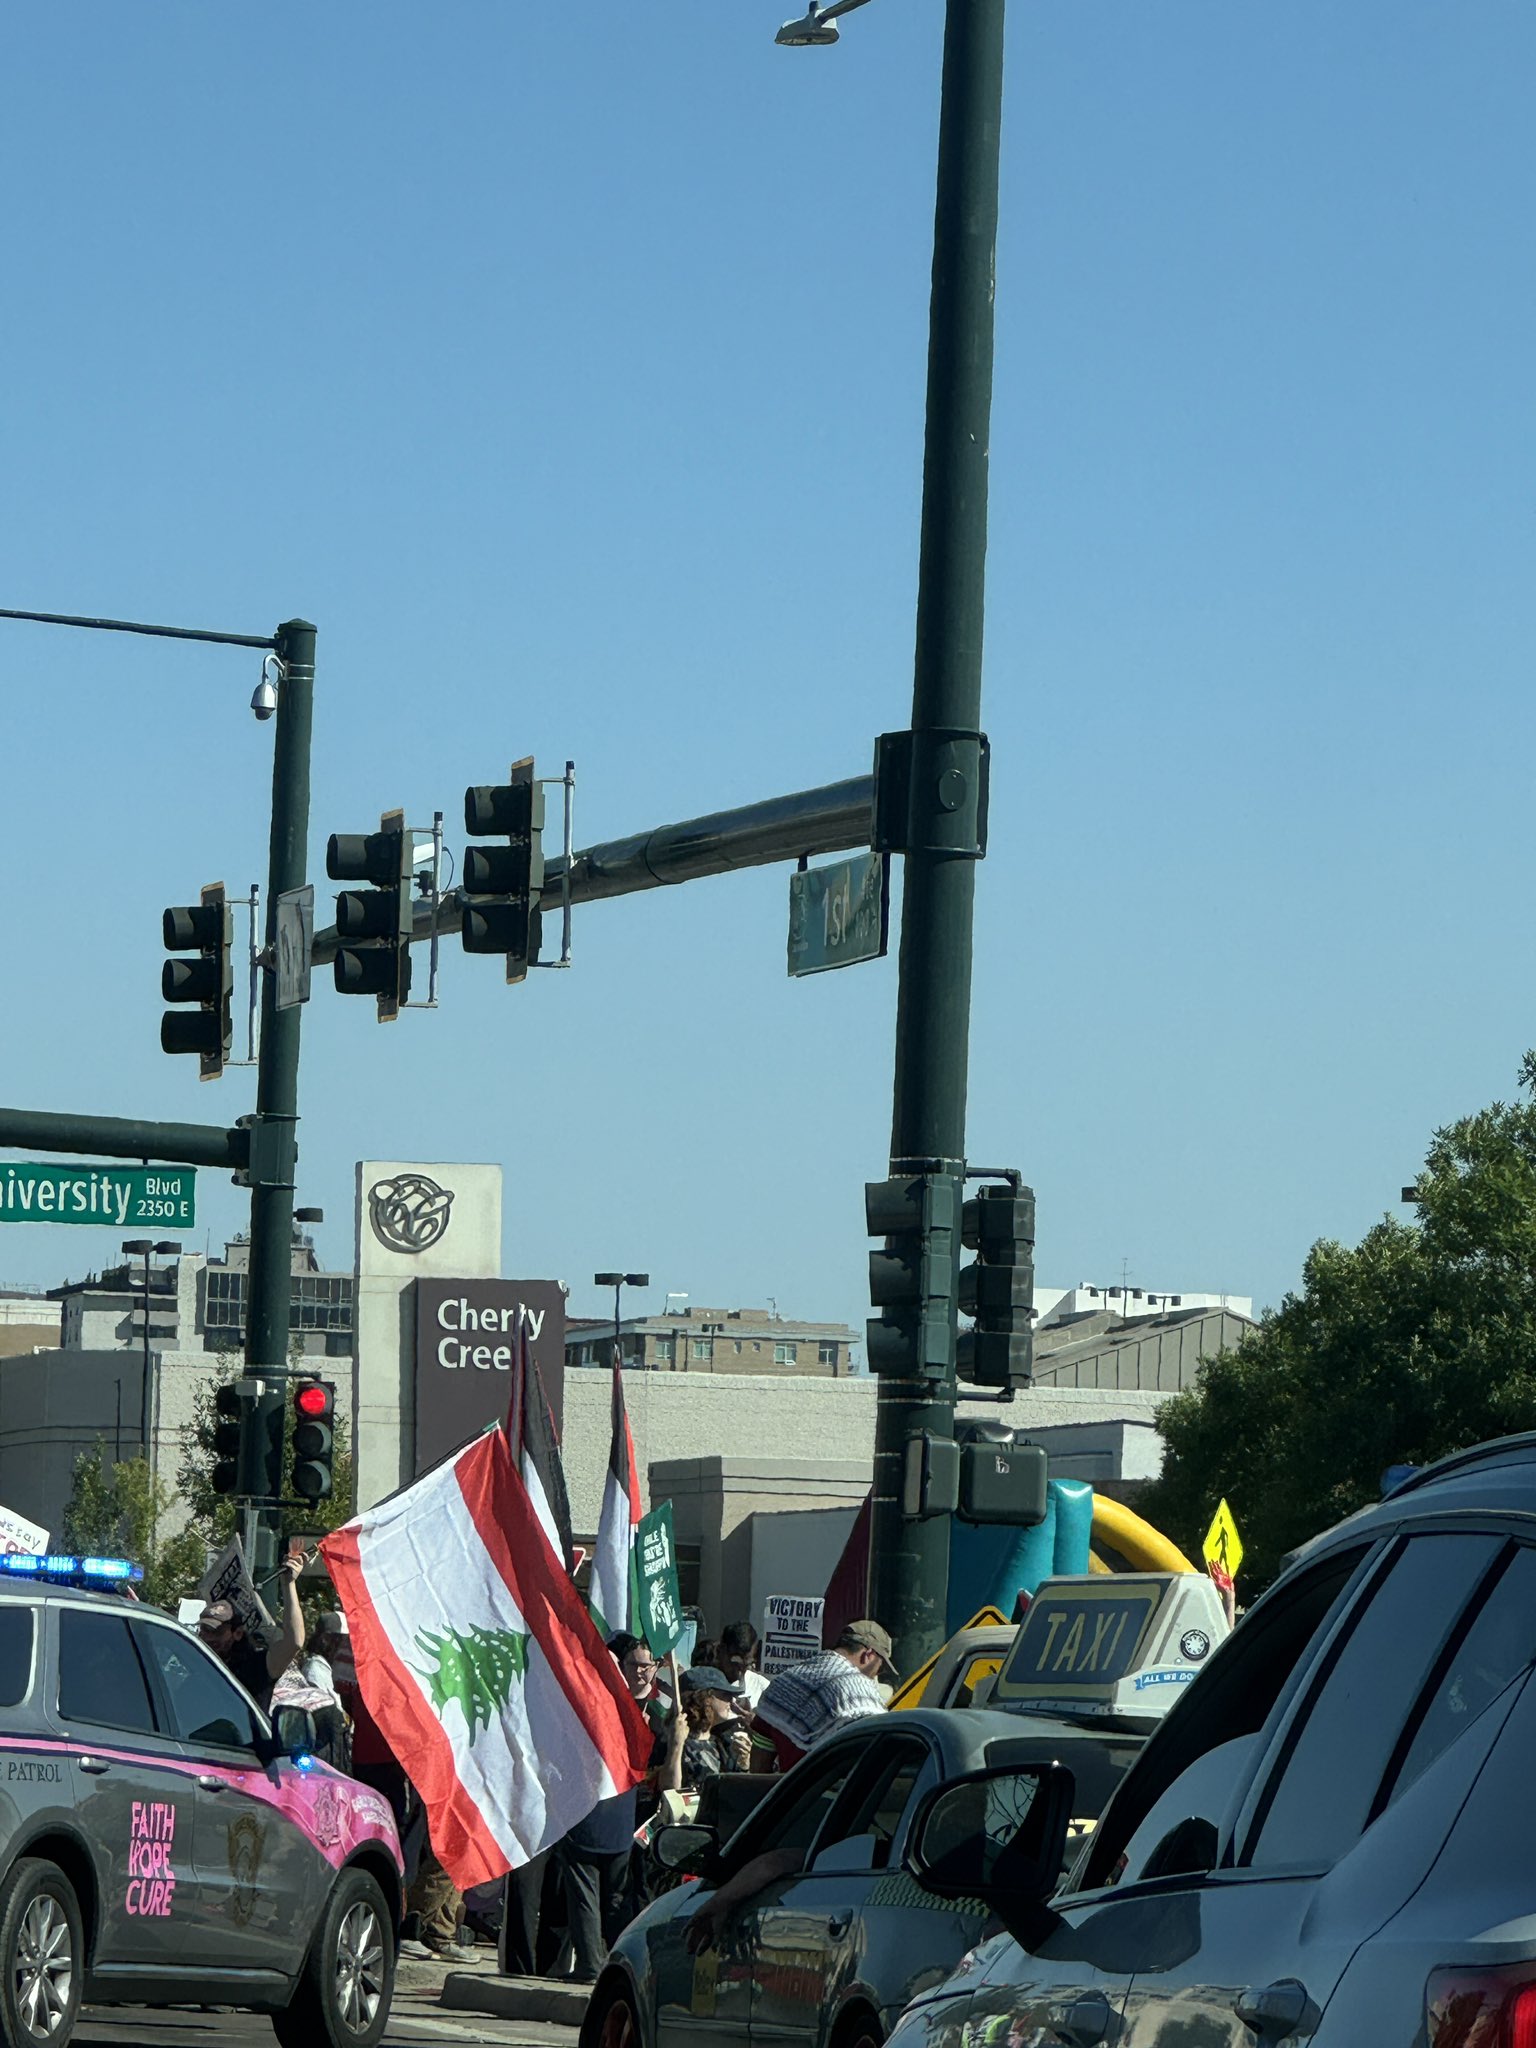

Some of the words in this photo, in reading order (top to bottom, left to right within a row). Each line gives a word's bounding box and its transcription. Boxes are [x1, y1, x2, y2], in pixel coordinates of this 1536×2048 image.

[822, 882, 850, 948] 1st
[145, 1177, 182, 1196] Blvd
[136, 1200, 175, 1217] 2350
[180, 1201, 189, 1217] E
[437, 1336, 512, 1370] Cree
[769, 1598, 824, 1618] VICTORY
[776, 1617, 789, 1631] TO
[791, 1618, 810, 1632] THE
[1035, 1610, 1129, 1672] TAXI
[1143, 1674, 1160, 1683] ALL
[8, 1761, 63, 1783] PATROL
[131, 1801, 176, 1841] FAITH
[128, 1839, 176, 1880] HOPE
[125, 1879, 176, 1916] CURE
